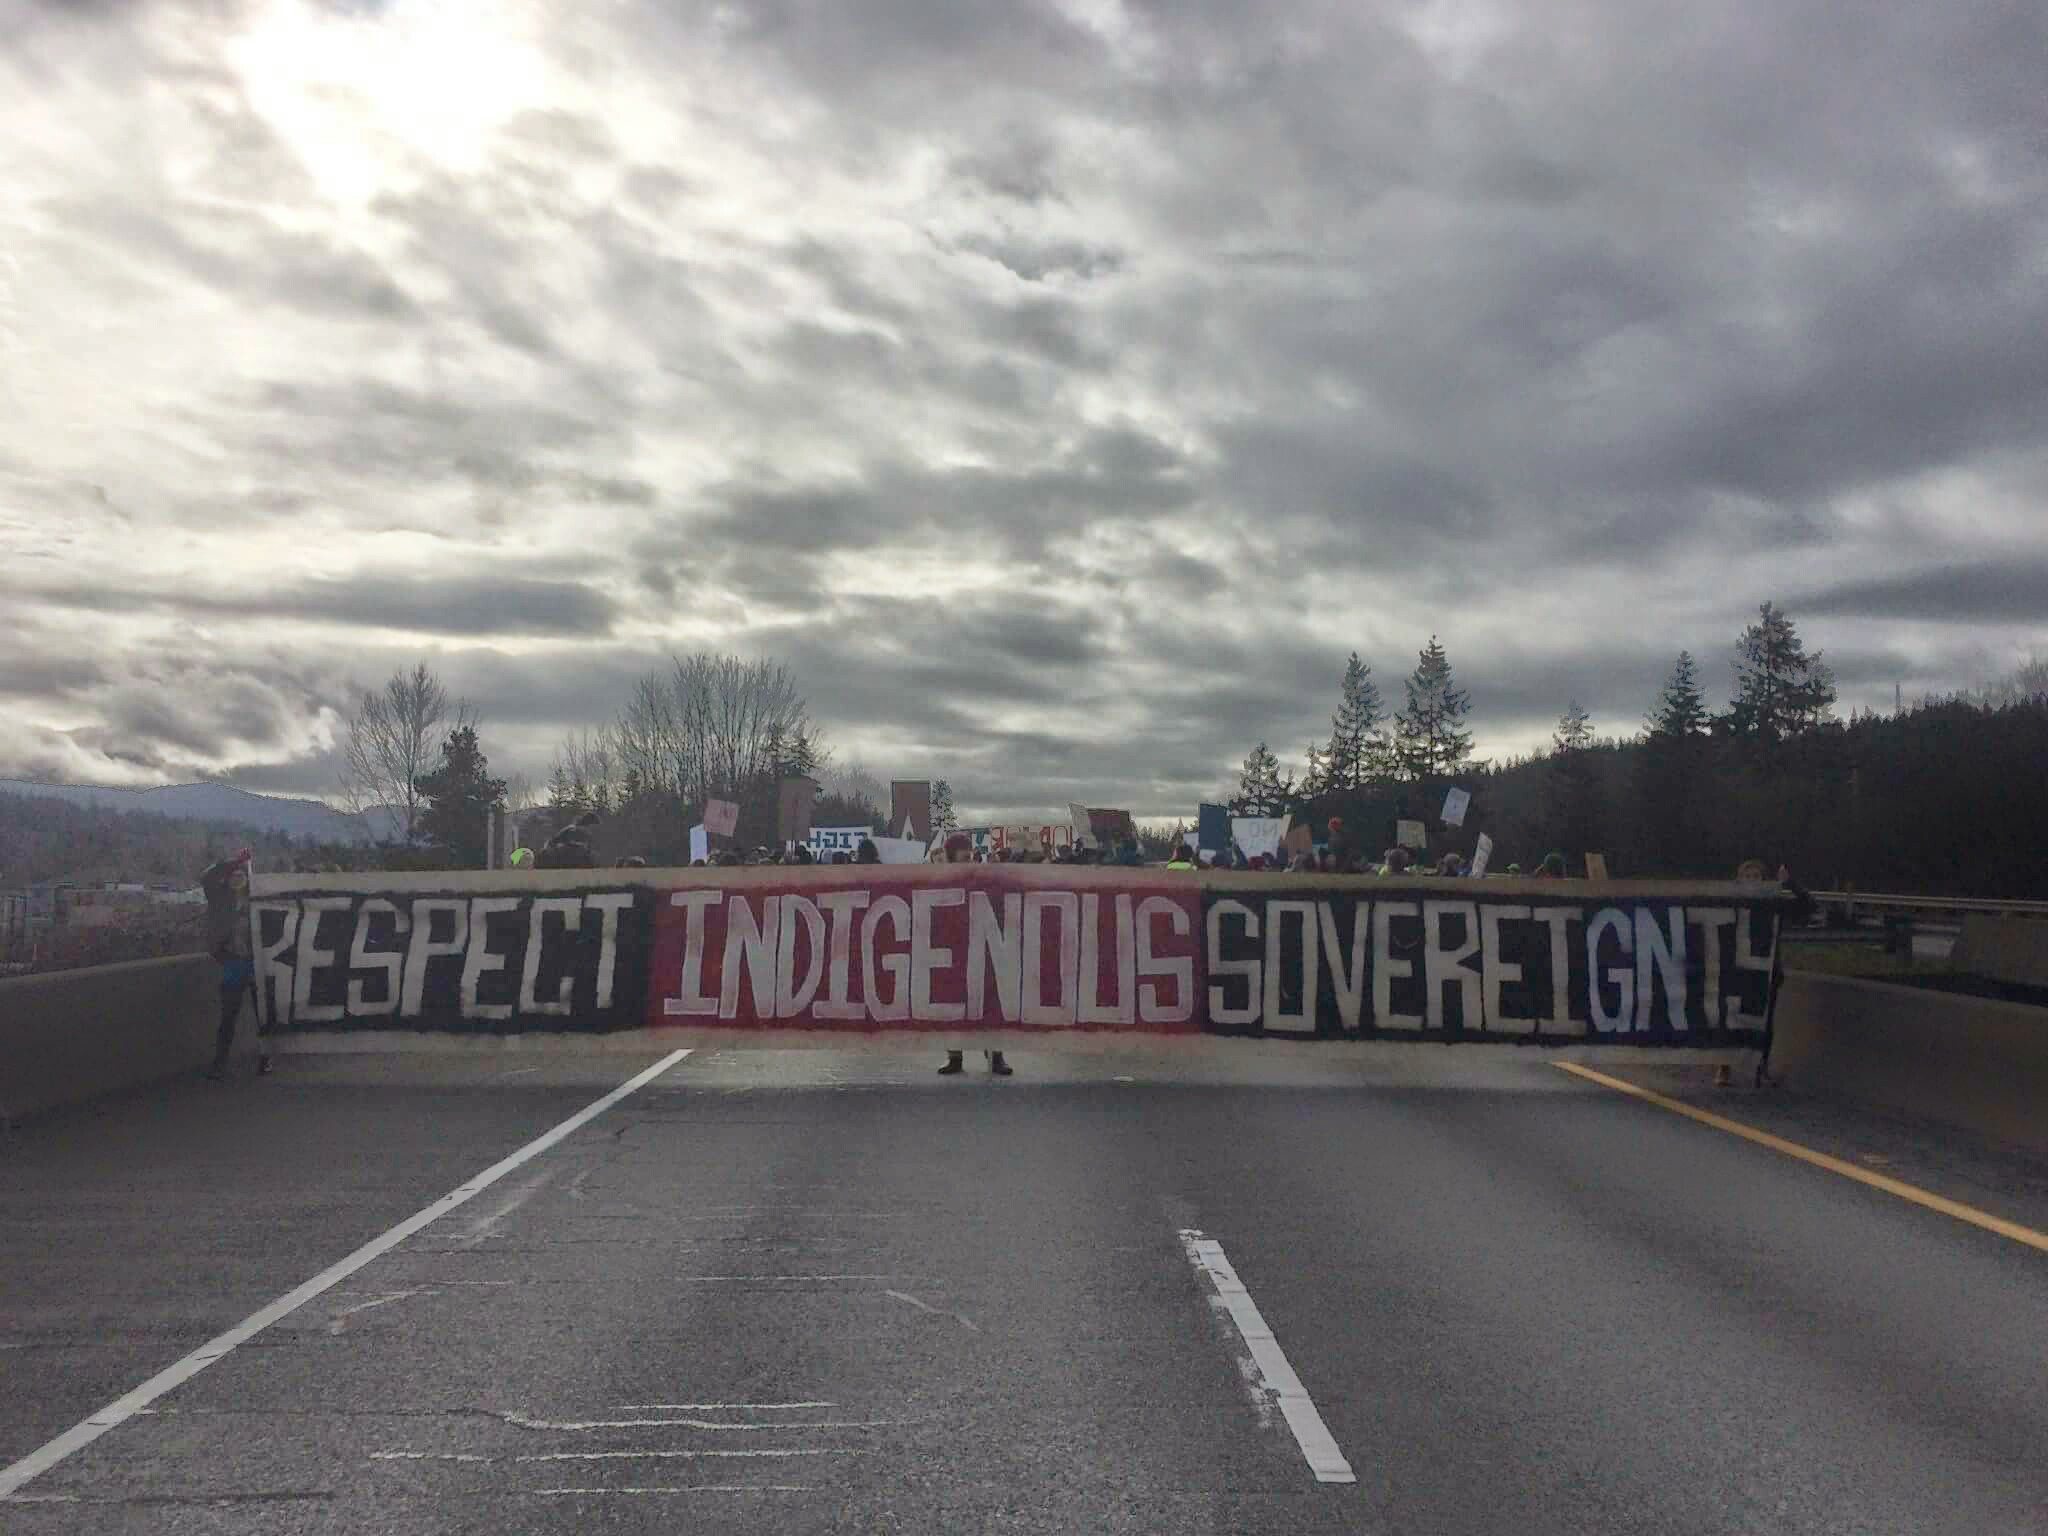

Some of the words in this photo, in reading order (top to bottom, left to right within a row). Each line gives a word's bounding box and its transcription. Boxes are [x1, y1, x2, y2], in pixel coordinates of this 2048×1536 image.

[251, 892, 635, 1025] RESPECT
[663, 887, 1195, 1025] INDIGENOUS
[1206, 898, 1780, 1036] SOVEREIGNTY
